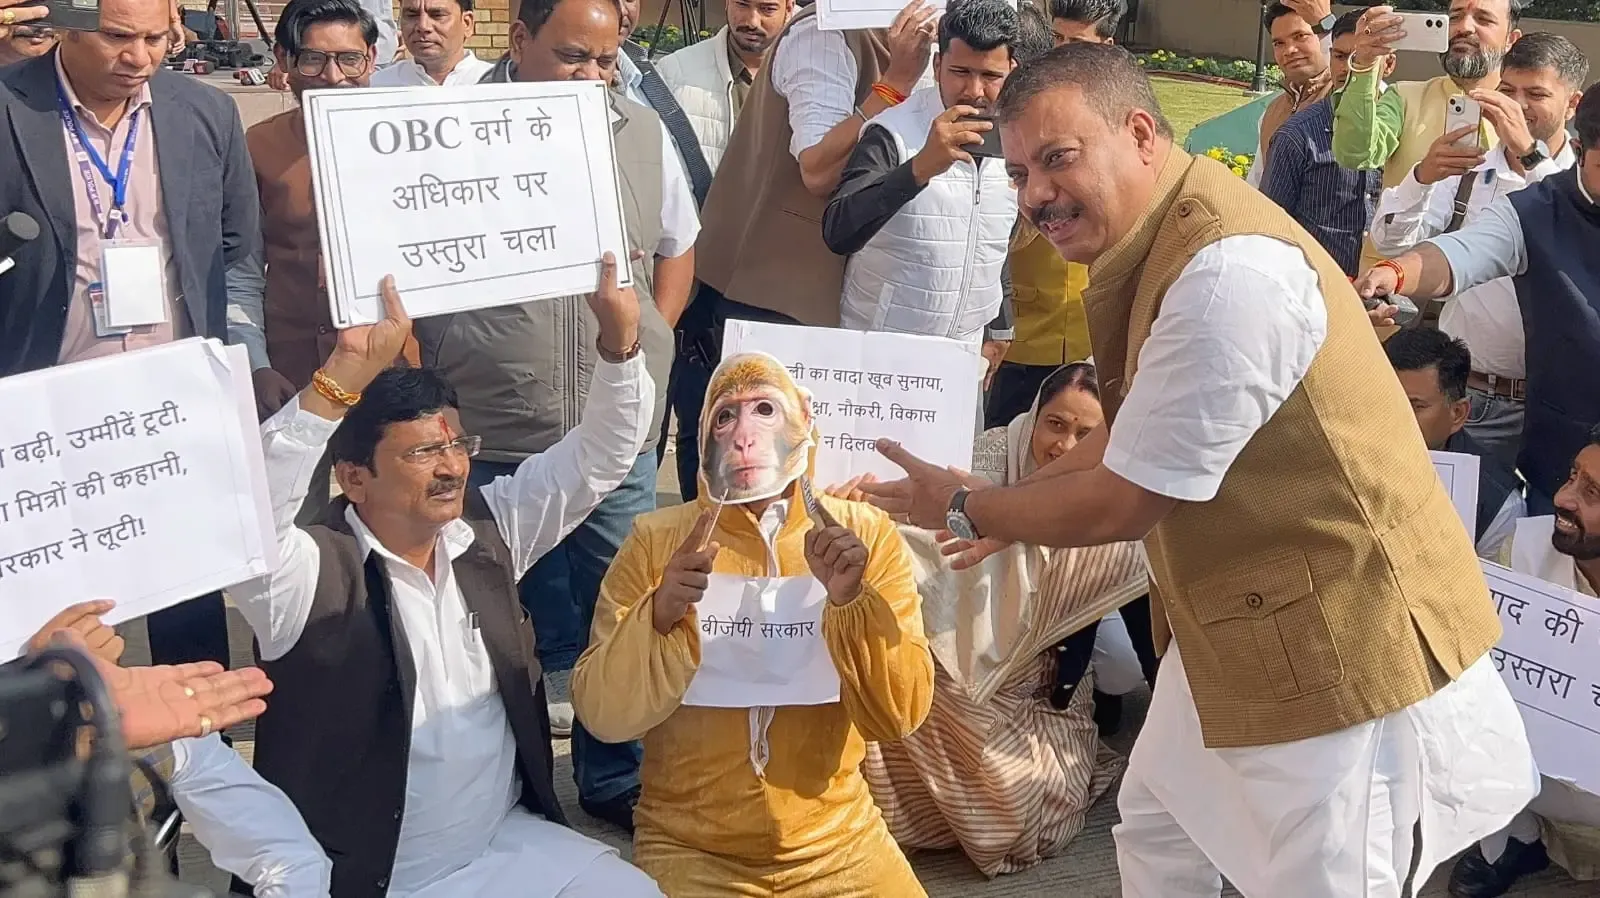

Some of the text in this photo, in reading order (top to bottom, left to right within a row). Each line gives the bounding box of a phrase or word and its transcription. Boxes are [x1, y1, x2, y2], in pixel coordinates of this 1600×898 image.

[369, 106, 552, 155] OBC वर्ग के
[392, 171, 548, 211] अधिकार पर
[398, 225, 556, 273] उस्तुरा चला
[809, 367, 828, 381] का
[833, 369, 863, 385] वादा
[868, 372, 893, 390] खूब
[896, 374, 943, 392] सुनाया,
[837, 398, 884, 421] नौकरी,
[889, 403, 937, 423] विकास
[10, 431, 61, 463] बढ़ी,
[66, 411, 136, 449] उम्मीदें
[140, 400, 187, 436] टूटी.
[824, 435, 836, 449] न
[15, 481, 67, 518] मित्रों
[72, 471, 105, 500] की
[110, 451, 187, 489] कहानी,
[68, 528, 88, 553] ने
[94, 514, 147, 551] लूटी!
[701, 615, 815, 639] बीजेपी सरकार
[1545, 608, 1584, 644] की
